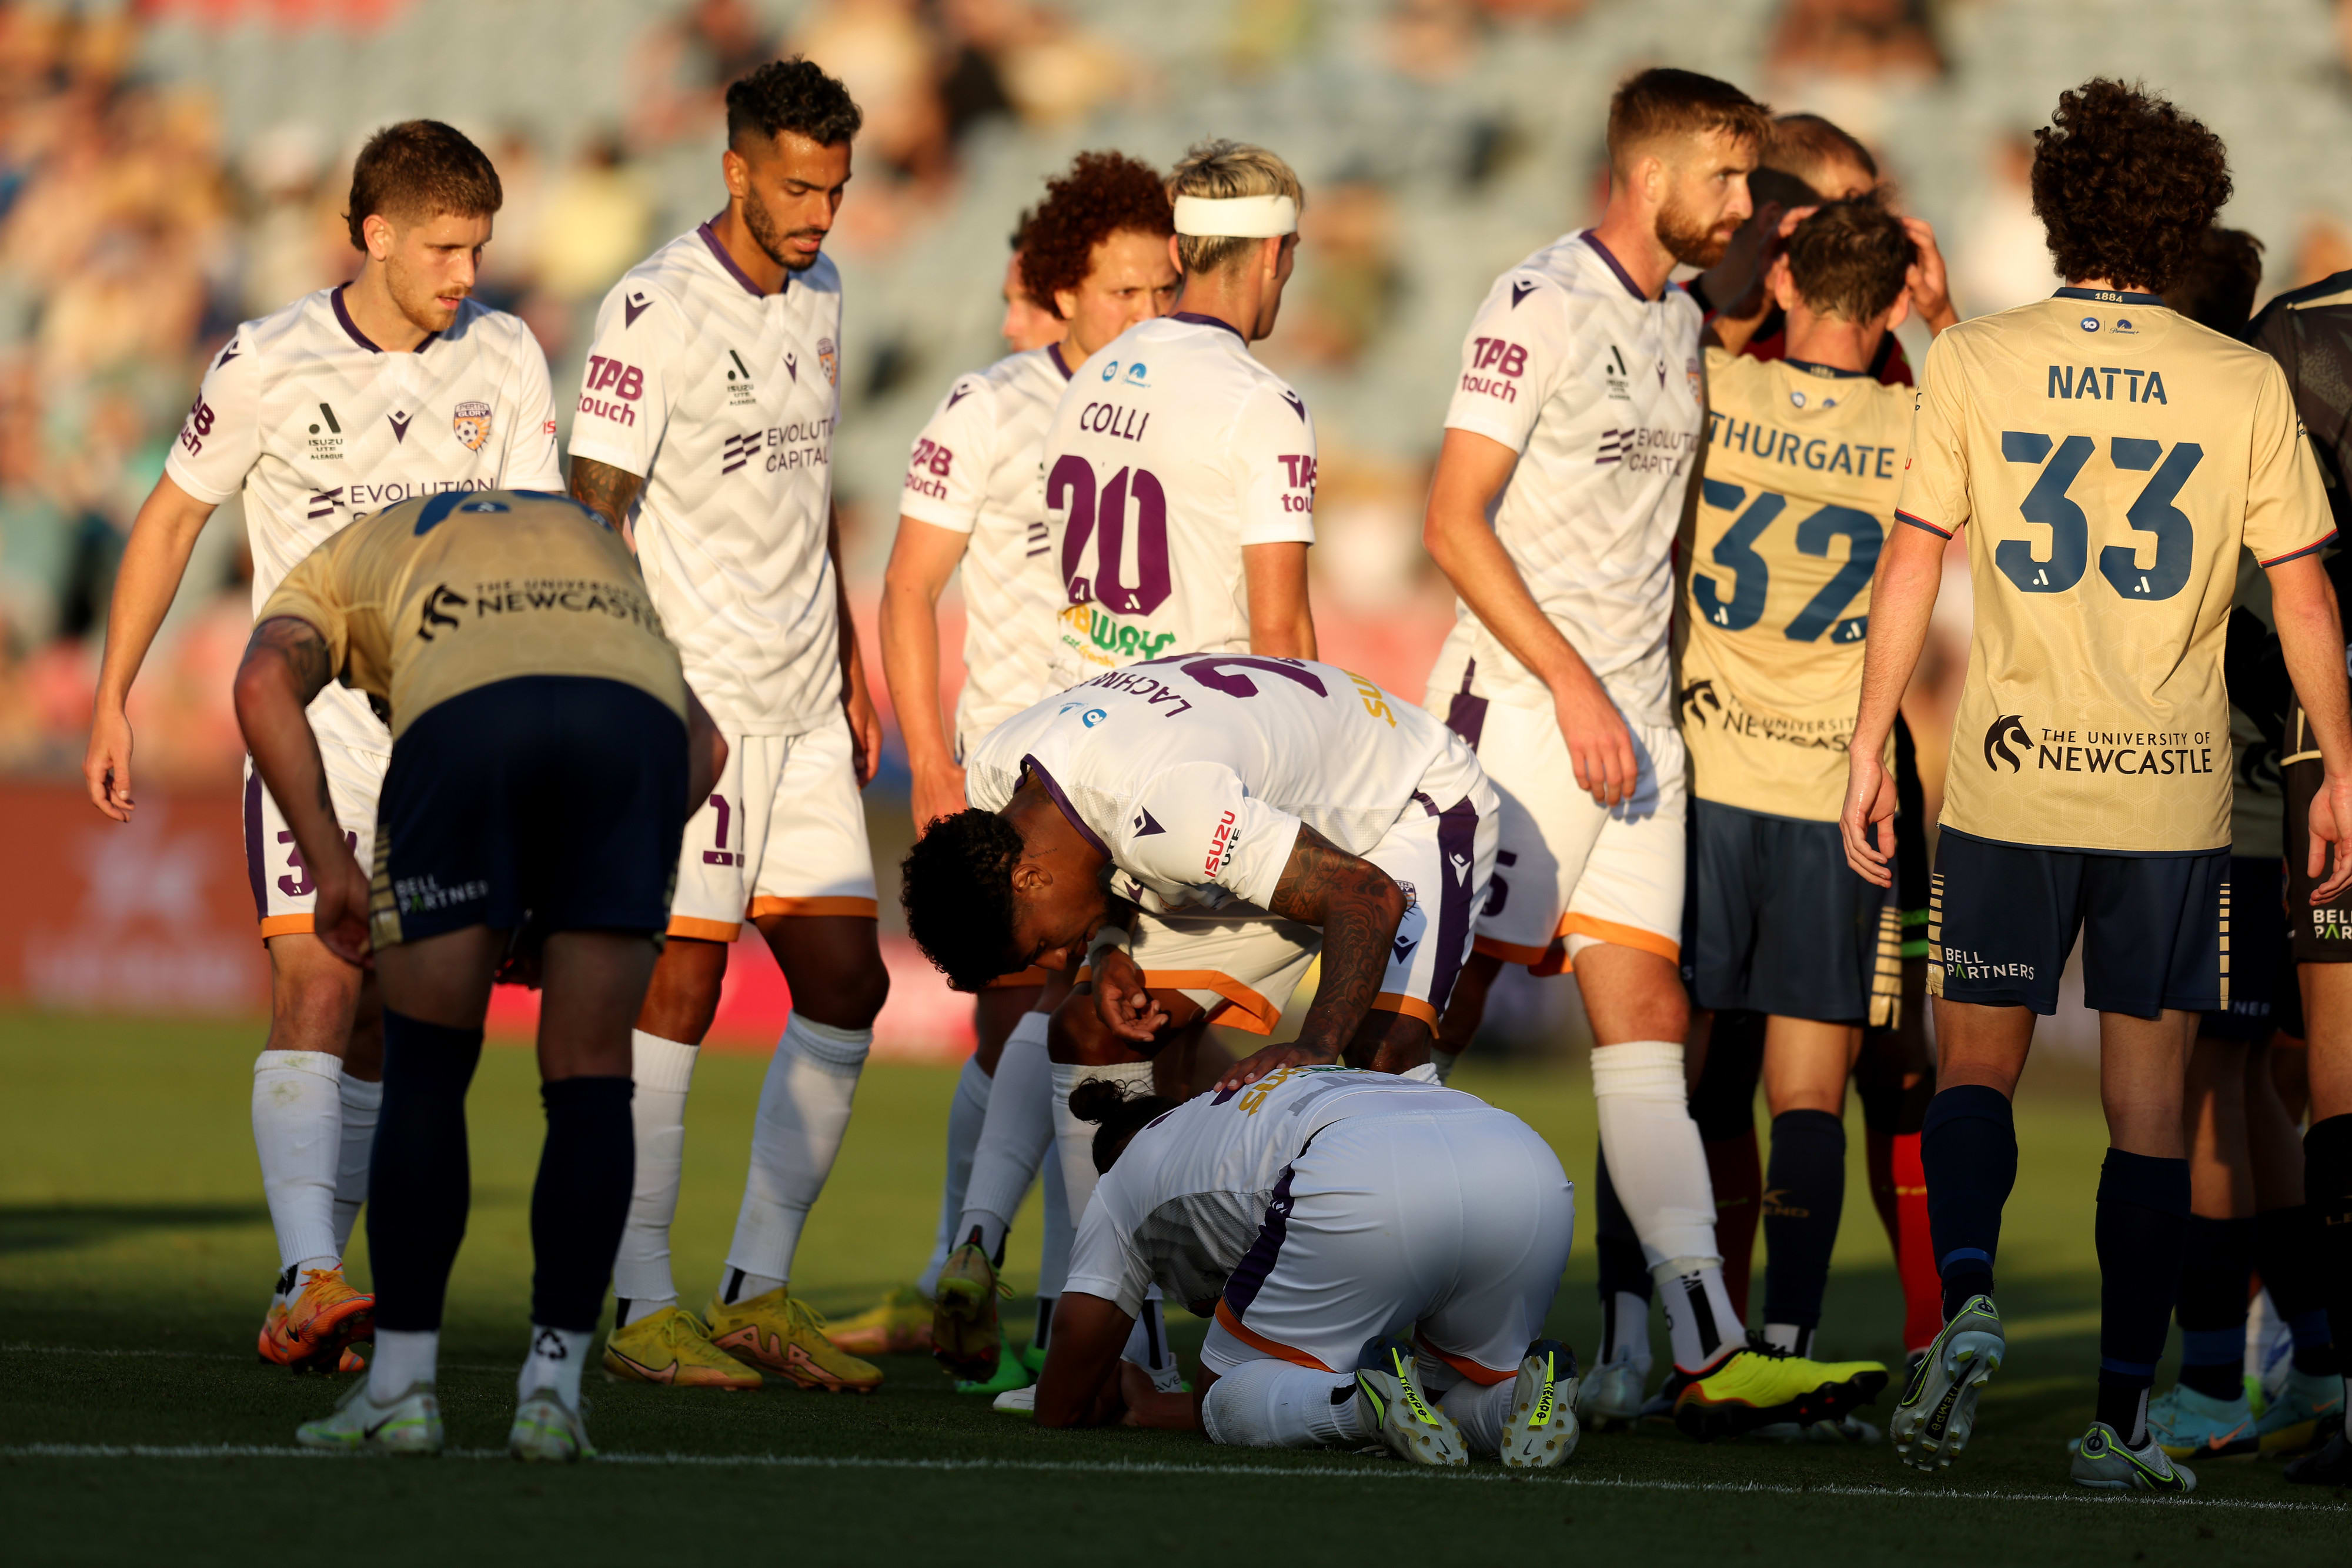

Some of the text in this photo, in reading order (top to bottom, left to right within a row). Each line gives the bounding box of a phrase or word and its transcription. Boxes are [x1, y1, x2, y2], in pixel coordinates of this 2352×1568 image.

[2094, 292, 2123, 303] 1884
[1472, 337, 1529, 378] TAB
[587, 355, 644, 401] TAB
[1462, 372, 1518, 404] touch
[2048, 365, 2167, 405] NATTA
[576, 392, 636, 427] touch
[1080, 402, 1150, 442] COLLI
[309, 438, 343, 446] ISUZU
[1709, 410, 1895, 479] THURGATE
[1046, 454, 1172, 617] 20
[1995, 431, 2204, 601] 33
[1692, 477, 1884, 644] 32
[2042, 728, 2210, 746] THE UNIVERSITY OF
[2038, 744, 2213, 775] NEWCASTLE
[1204, 810, 1236, 878] ISUZU
[1221, 828, 1242, 866] UTE
[2313, 909, 2352, 924] BEL
[1945, 947, 1984, 964] BELL
[1946, 963, 2034, 980] PARTNERS
[1399, 1376, 1428, 1420] TIEMPO
[1536, 1380, 1553, 1423] TIEMPO
[1930, 1385, 1960, 1435] TIEMPO
